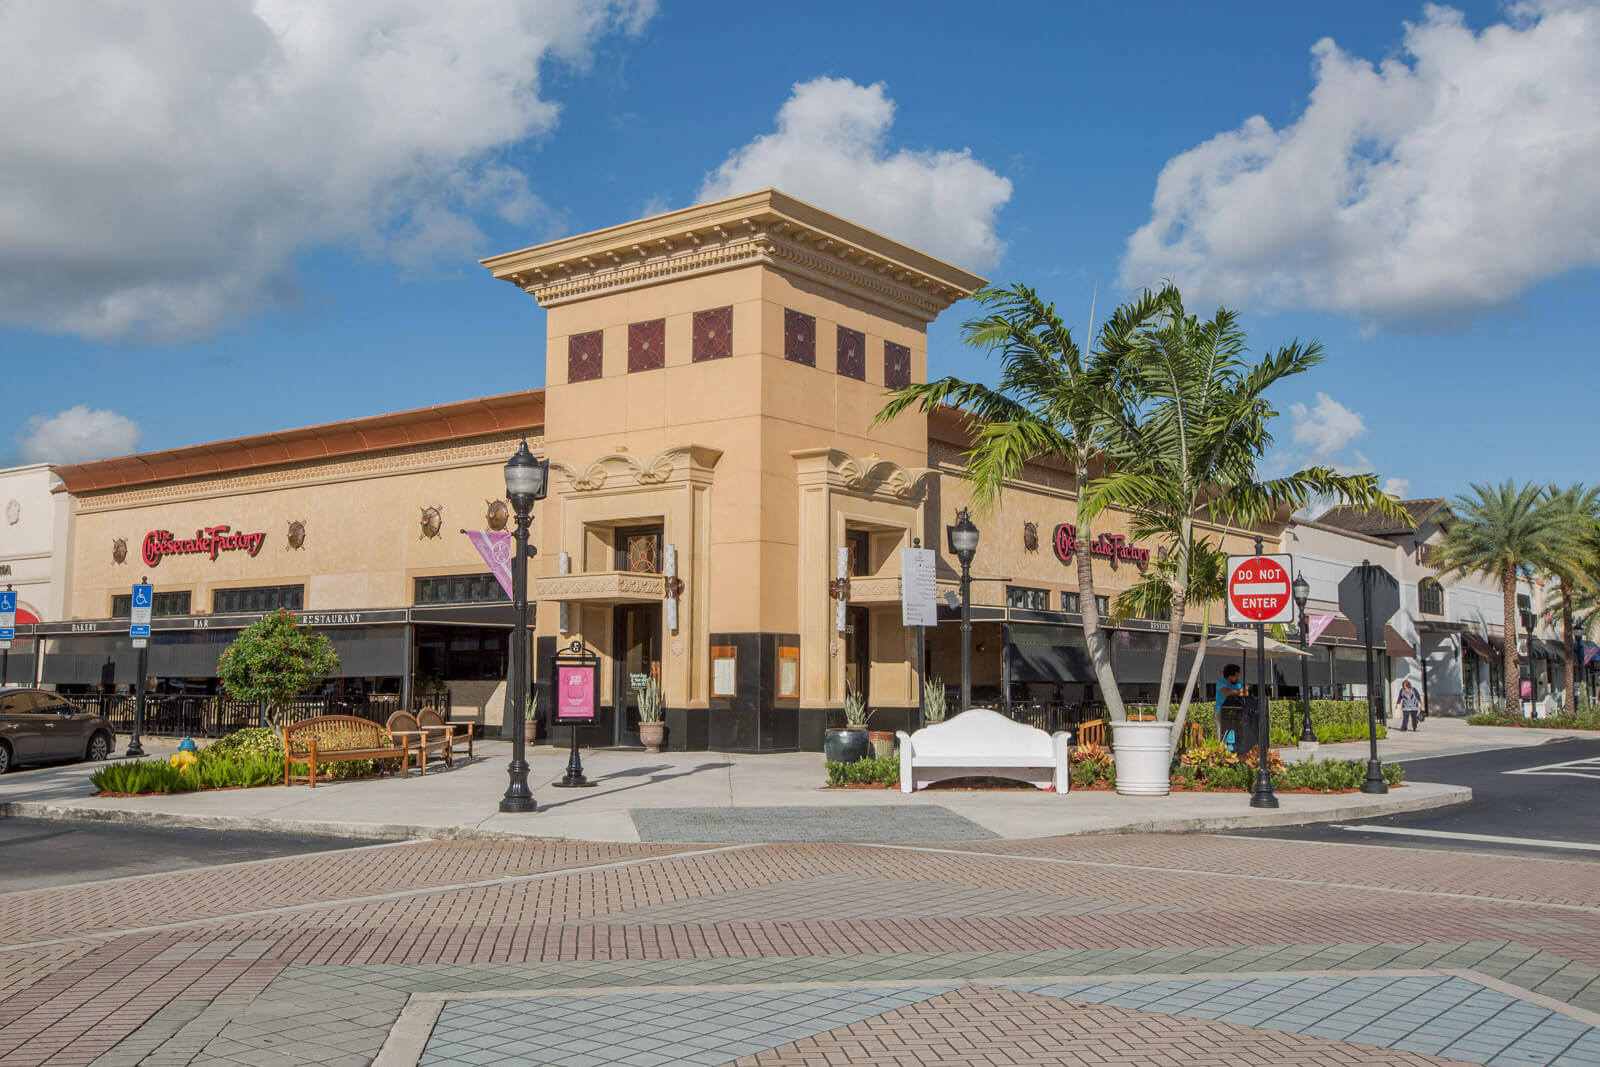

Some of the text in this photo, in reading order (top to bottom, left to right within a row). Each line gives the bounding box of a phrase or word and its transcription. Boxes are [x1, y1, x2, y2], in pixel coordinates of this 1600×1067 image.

[142, 529, 210, 567] Cheesecake
[204, 525, 265, 561] Factory
[1109, 533, 1151, 571] Factory
[1238, 568, 1281, 580] DO NOT
[1242, 597, 1278, 609] ENTER
[193, 619, 209, 628] BAR
[302, 614, 361, 625] RESTAURANT
[71, 623, 97, 632] BAKERY
